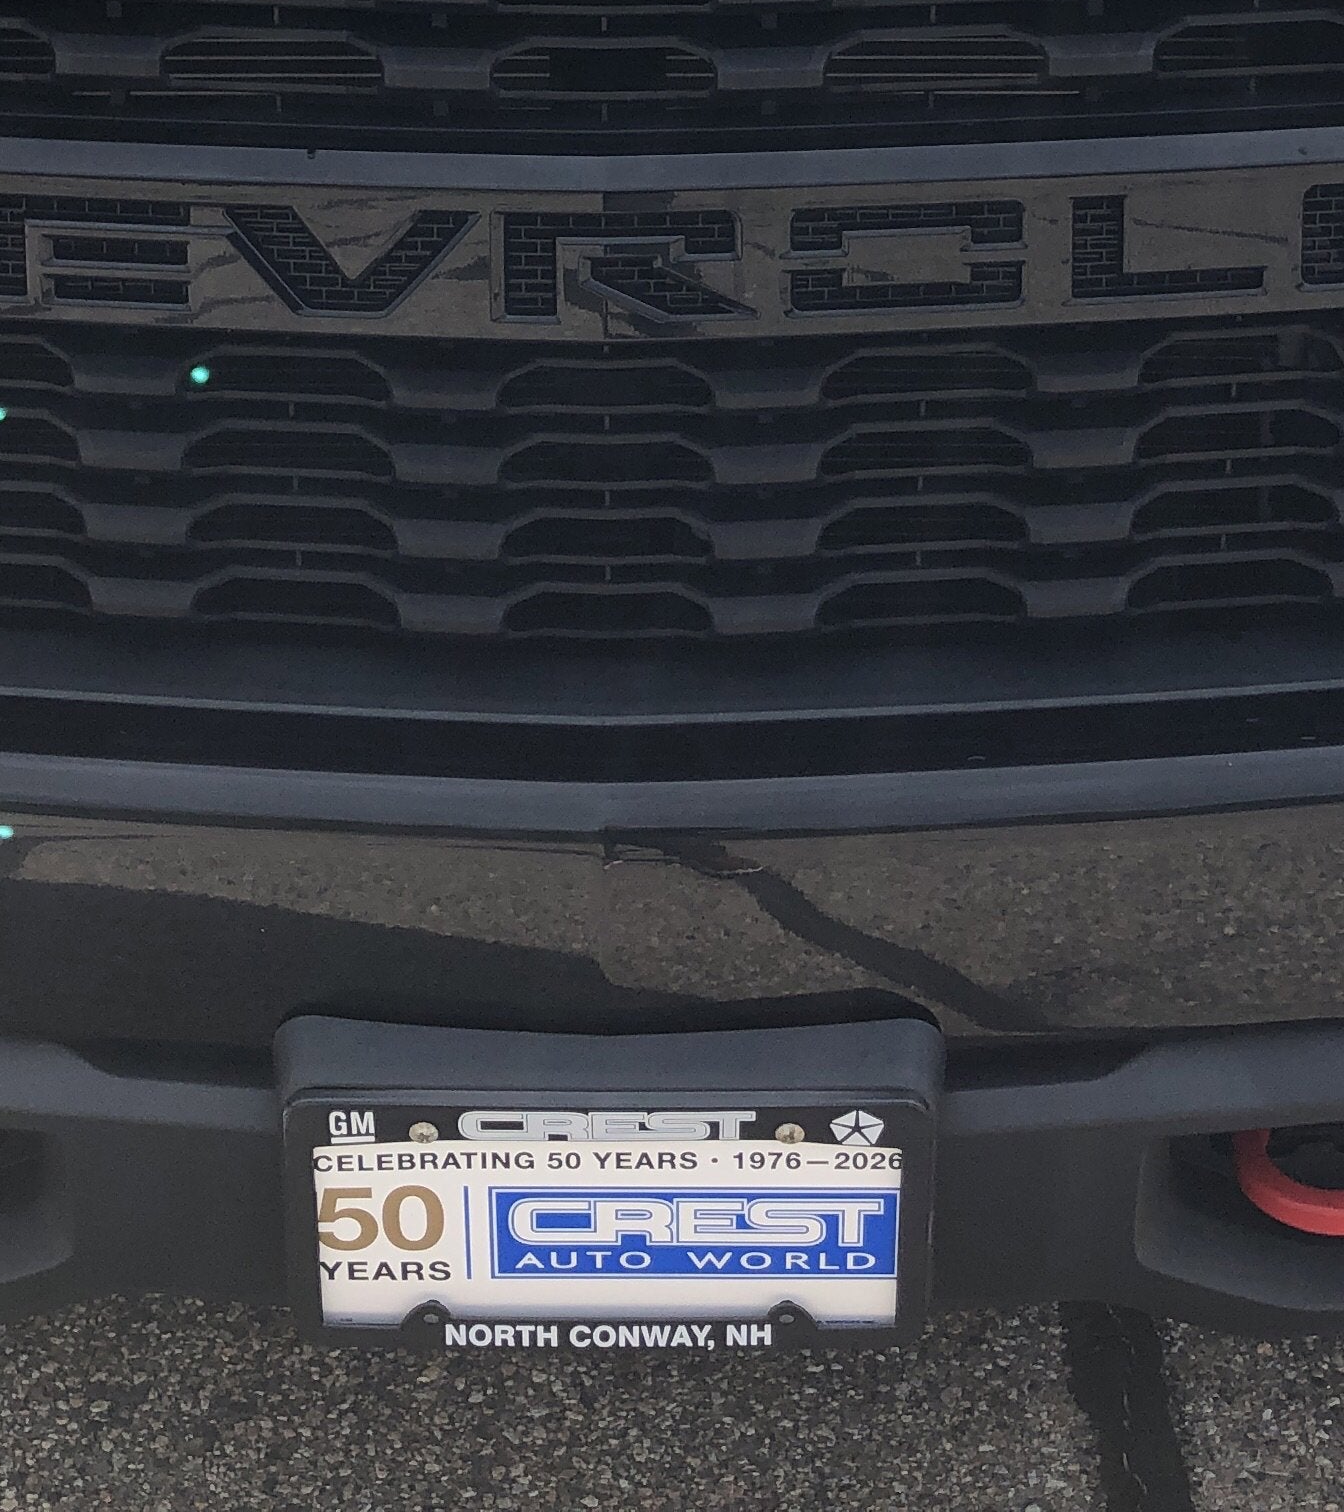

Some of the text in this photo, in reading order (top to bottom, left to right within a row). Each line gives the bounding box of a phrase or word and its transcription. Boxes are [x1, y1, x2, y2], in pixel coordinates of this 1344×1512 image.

[328, 1111, 376, 1136] GM
[457, 1110, 756, 1141] CREST
[313, 1151, 535, 1172] CELEBRATING
[547, 1152, 581, 1170] 50
[592, 1151, 698, 1170] YEARS
[318, 1185, 445, 1251] 50
[507, 1197, 885, 1248] CREST
[320, 1261, 452, 1281] YEARS
[515, 1251, 877, 1270] AUTO WORLD
[444, 1323, 773, 1351] NORTH CONWAY, NH
